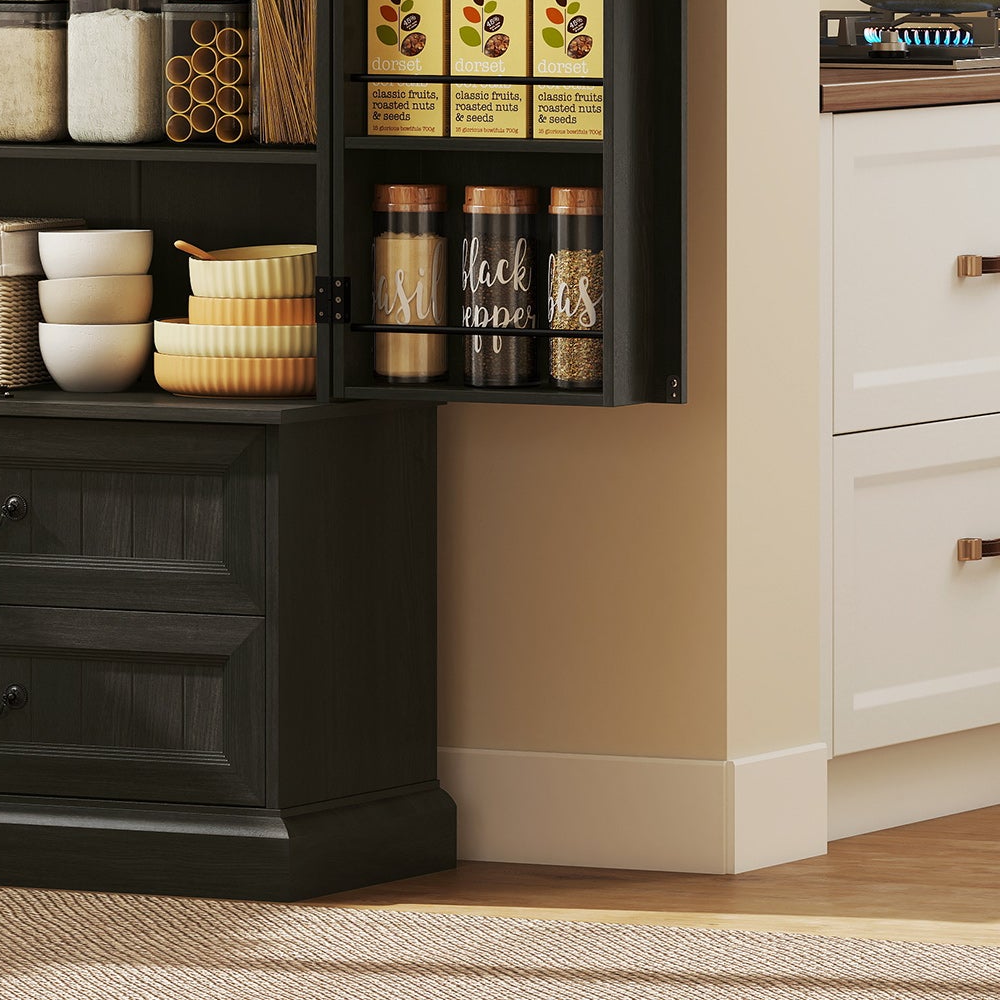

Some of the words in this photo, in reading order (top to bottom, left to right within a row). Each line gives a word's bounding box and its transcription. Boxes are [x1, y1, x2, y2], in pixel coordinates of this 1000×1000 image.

[372, 56, 422, 71] dorset
[455, 58, 505, 72] dorset
[537, 59, 588, 74] dorset
[372, 89, 406, 99] classic
[408, 90, 438, 100] fruits,
[456, 91, 489, 100] classic
[492, 91, 522, 102] fruits,
[538, 92, 572, 101] classic
[372, 101, 410, 109] roasted
[412, 102, 435, 110] nuts
[456, 102, 493, 111] roasted
[496, 103, 518, 111] nuts
[538, 104, 576, 112] roasted
[578, 105, 602, 113] nuts
[372, 111, 381, 120] &
[383, 112, 411, 120] seeds
[456, 113, 464, 122] &
[466, 113, 494, 122] seeds
[538, 114, 547, 123] &
[549, 115, 577, 124] seeds
[462, 237, 532, 293] black
[548, 253, 603, 327] bas
